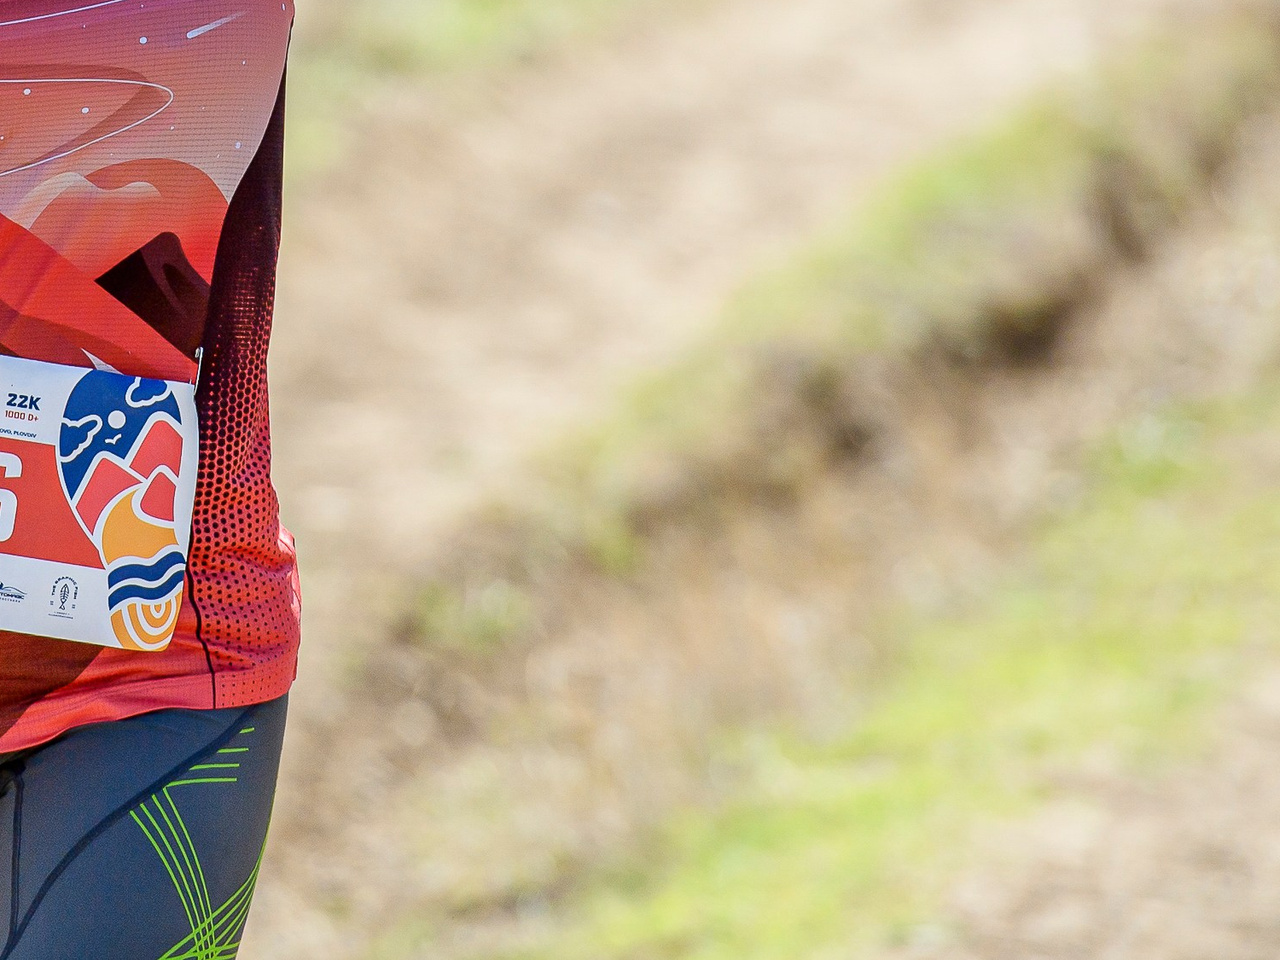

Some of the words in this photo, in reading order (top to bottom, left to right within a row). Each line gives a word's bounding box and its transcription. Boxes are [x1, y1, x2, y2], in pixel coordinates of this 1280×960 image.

[6, 393, 41, 411] 22K
[5, 410, 26, 420] 1000
[27, 413, 39, 422] D+
[13, 430, 37, 438] PLOVDIV
